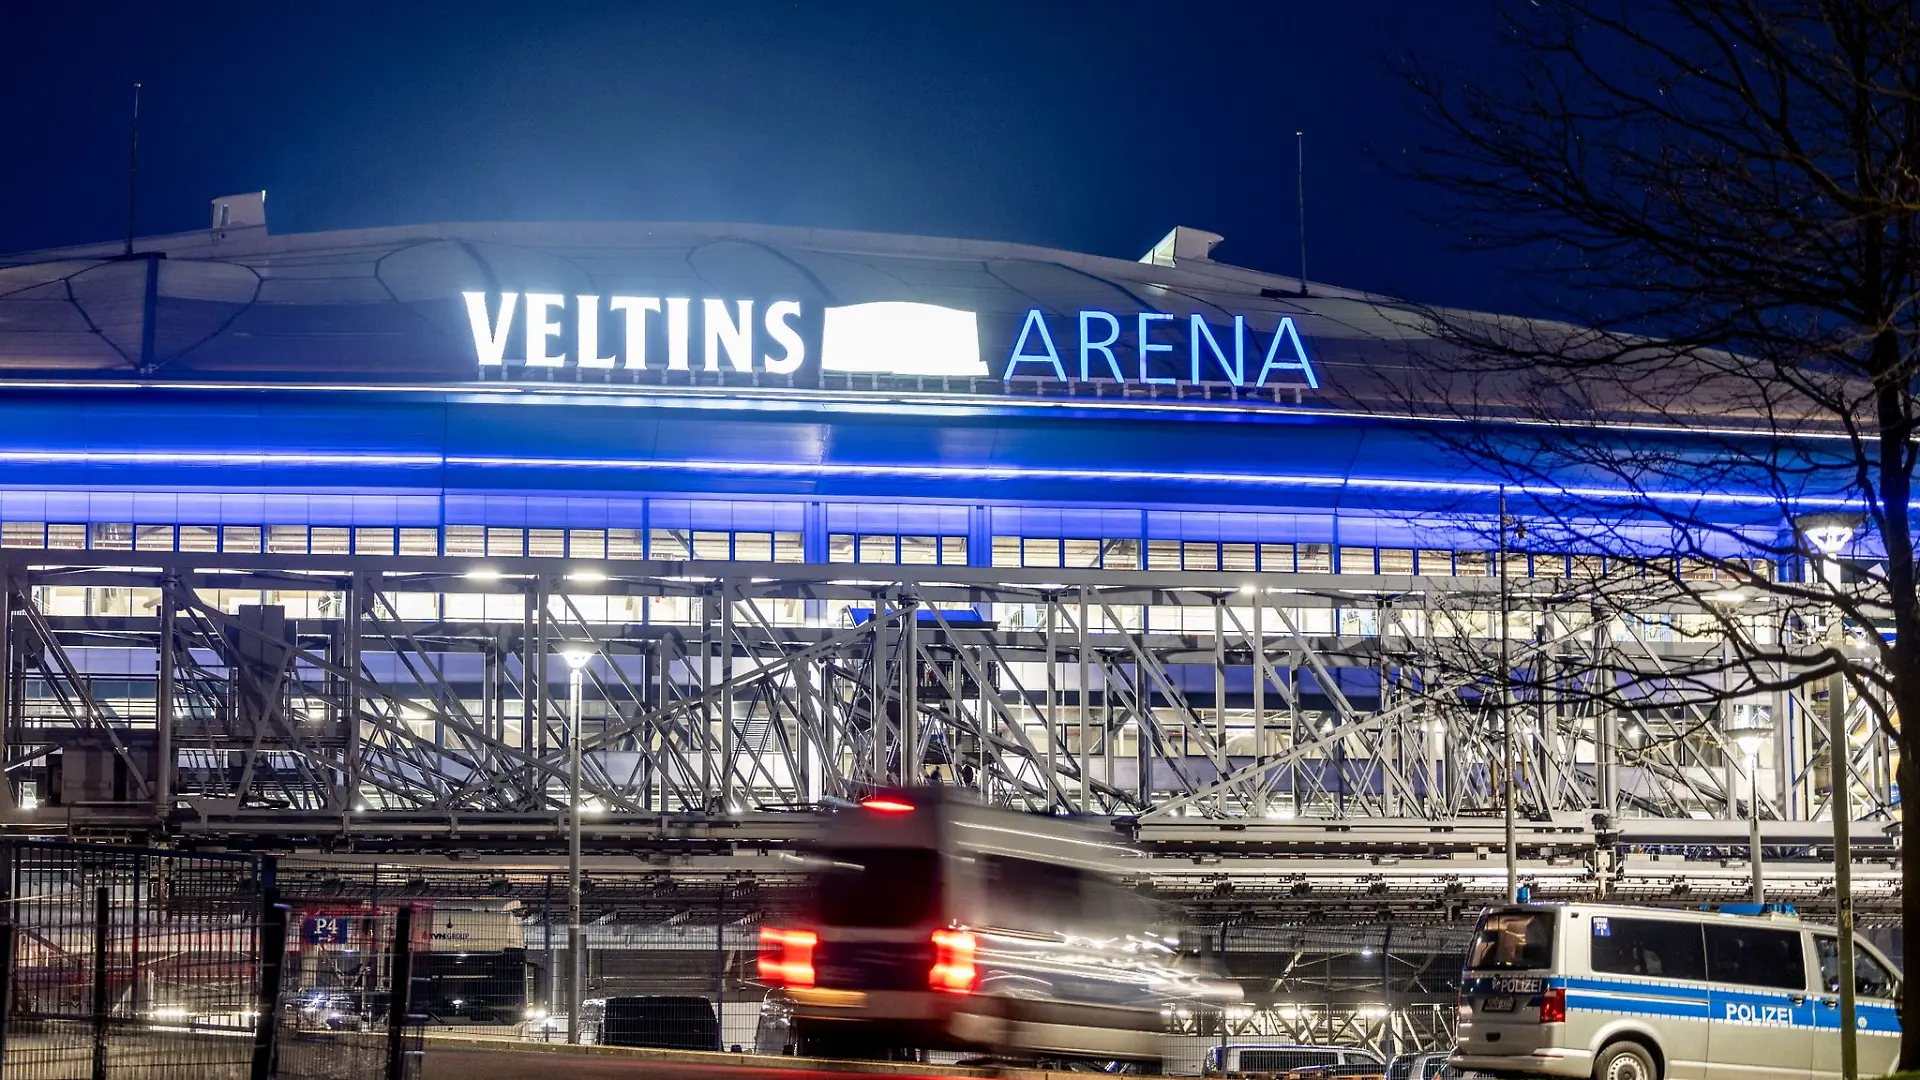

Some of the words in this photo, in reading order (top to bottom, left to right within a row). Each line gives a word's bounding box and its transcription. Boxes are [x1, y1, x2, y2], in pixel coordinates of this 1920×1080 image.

[462, 291, 805, 374] VELTINS
[1003, 309, 1319, 389] ARENA
[314, 918, 338, 934] P4
[1501, 979, 1542, 993] POLIZEI
[1726, 1003, 1794, 1025] POLIZEI
